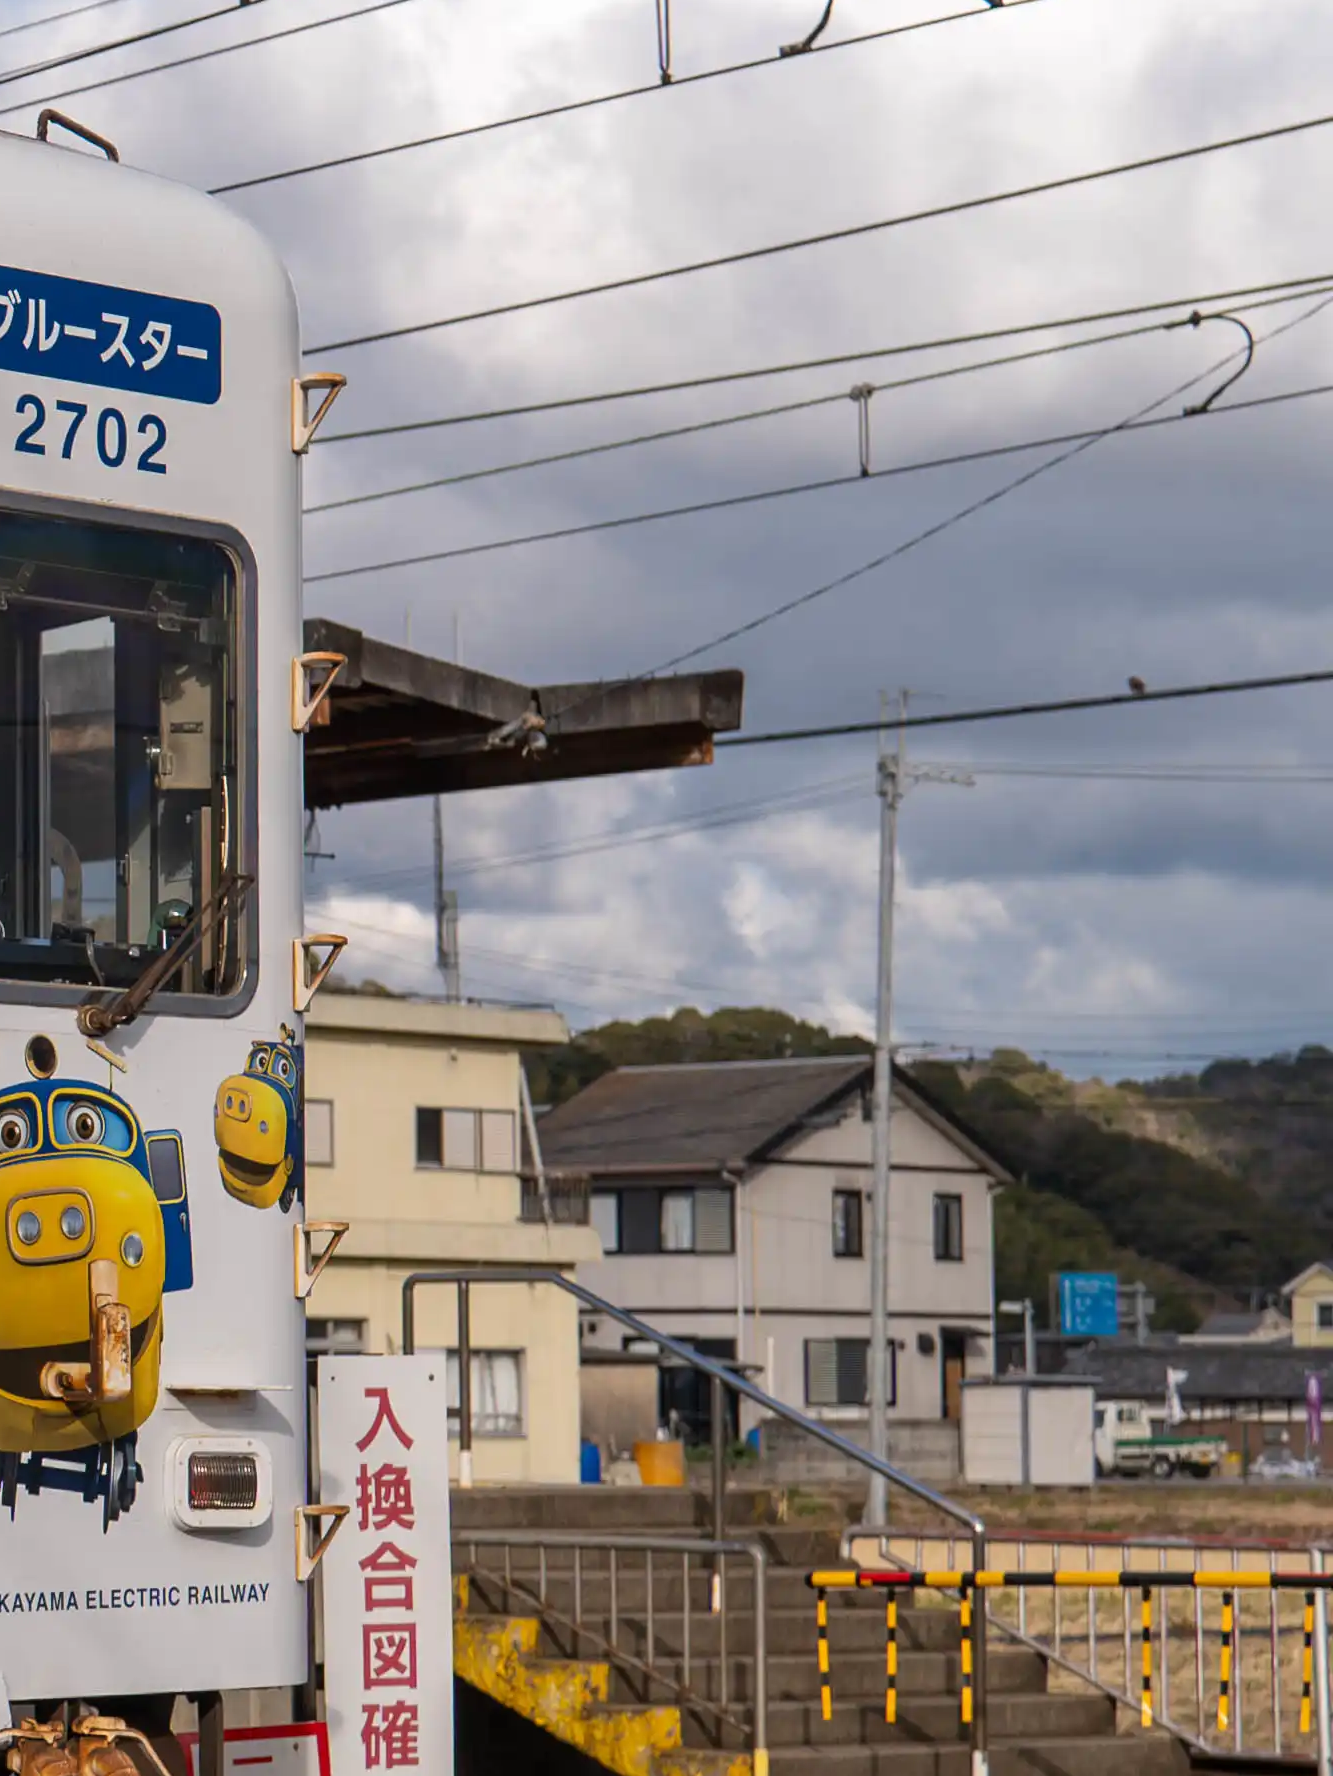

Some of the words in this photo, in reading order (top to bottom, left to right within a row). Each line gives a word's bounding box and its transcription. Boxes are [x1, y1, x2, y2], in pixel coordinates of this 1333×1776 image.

[14, 393, 168, 475] 2702
[86, 1585, 181, 1610] ELECTRIC
[187, 1582, 271, 1606] RAILWAY
